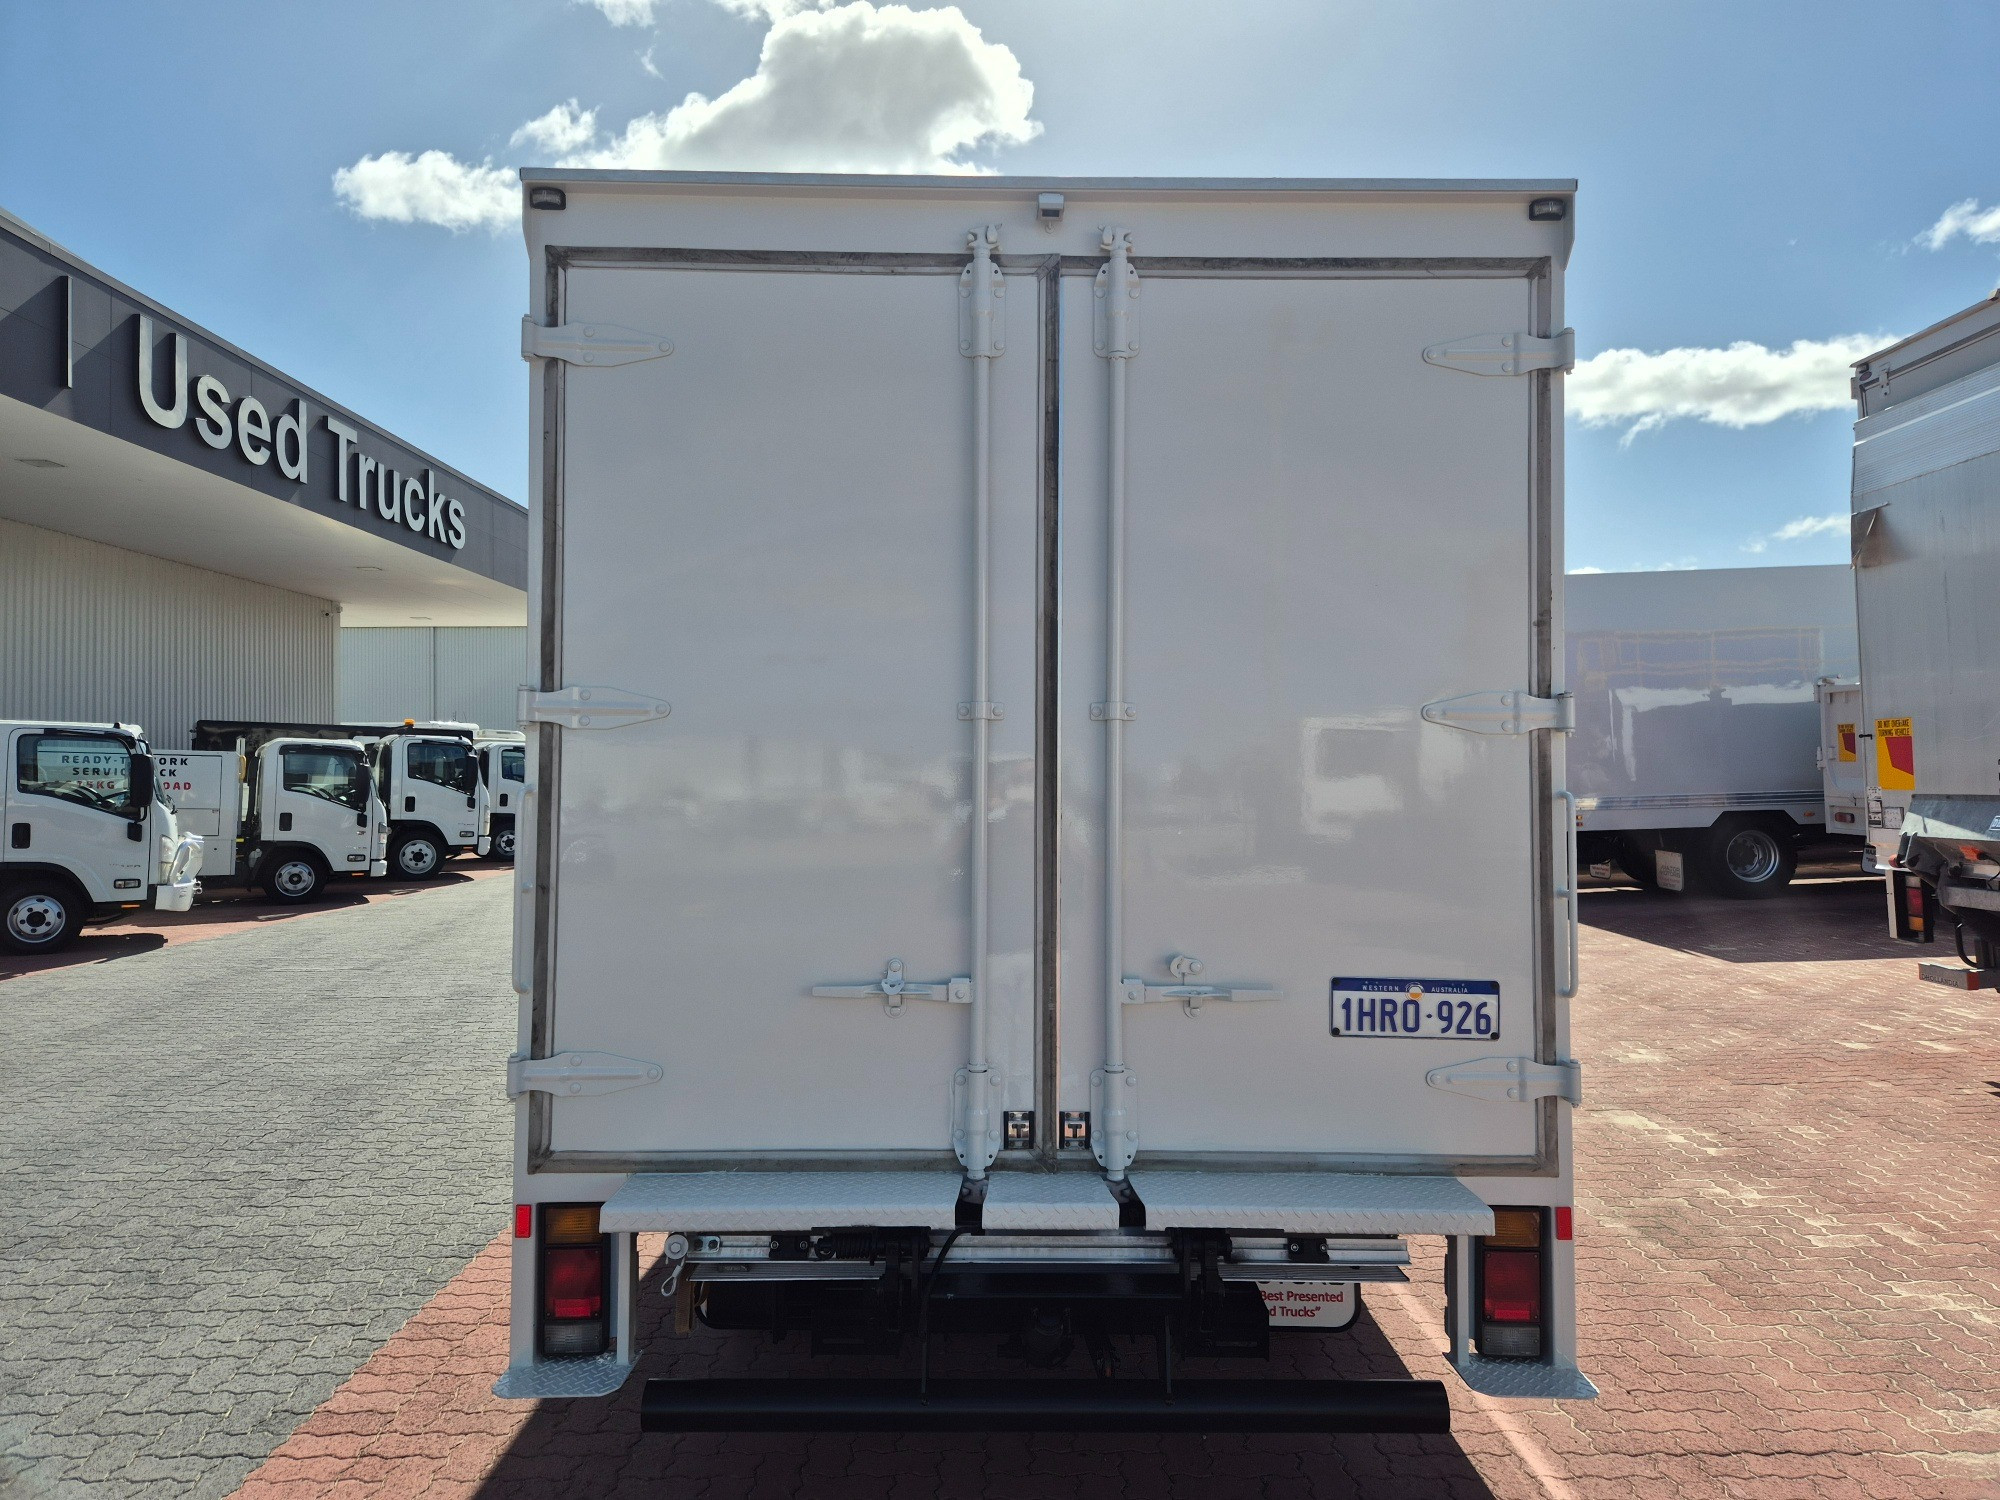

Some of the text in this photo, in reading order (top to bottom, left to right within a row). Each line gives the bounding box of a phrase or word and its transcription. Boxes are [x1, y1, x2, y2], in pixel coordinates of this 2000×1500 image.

[134, 313, 467, 550] Used Trucks
[1921, 973, 1959, 987] DHOLLANDIA
[1431, 986, 1468, 994] AUSTRALIA
[1286, 1290, 1344, 1302] Presented
